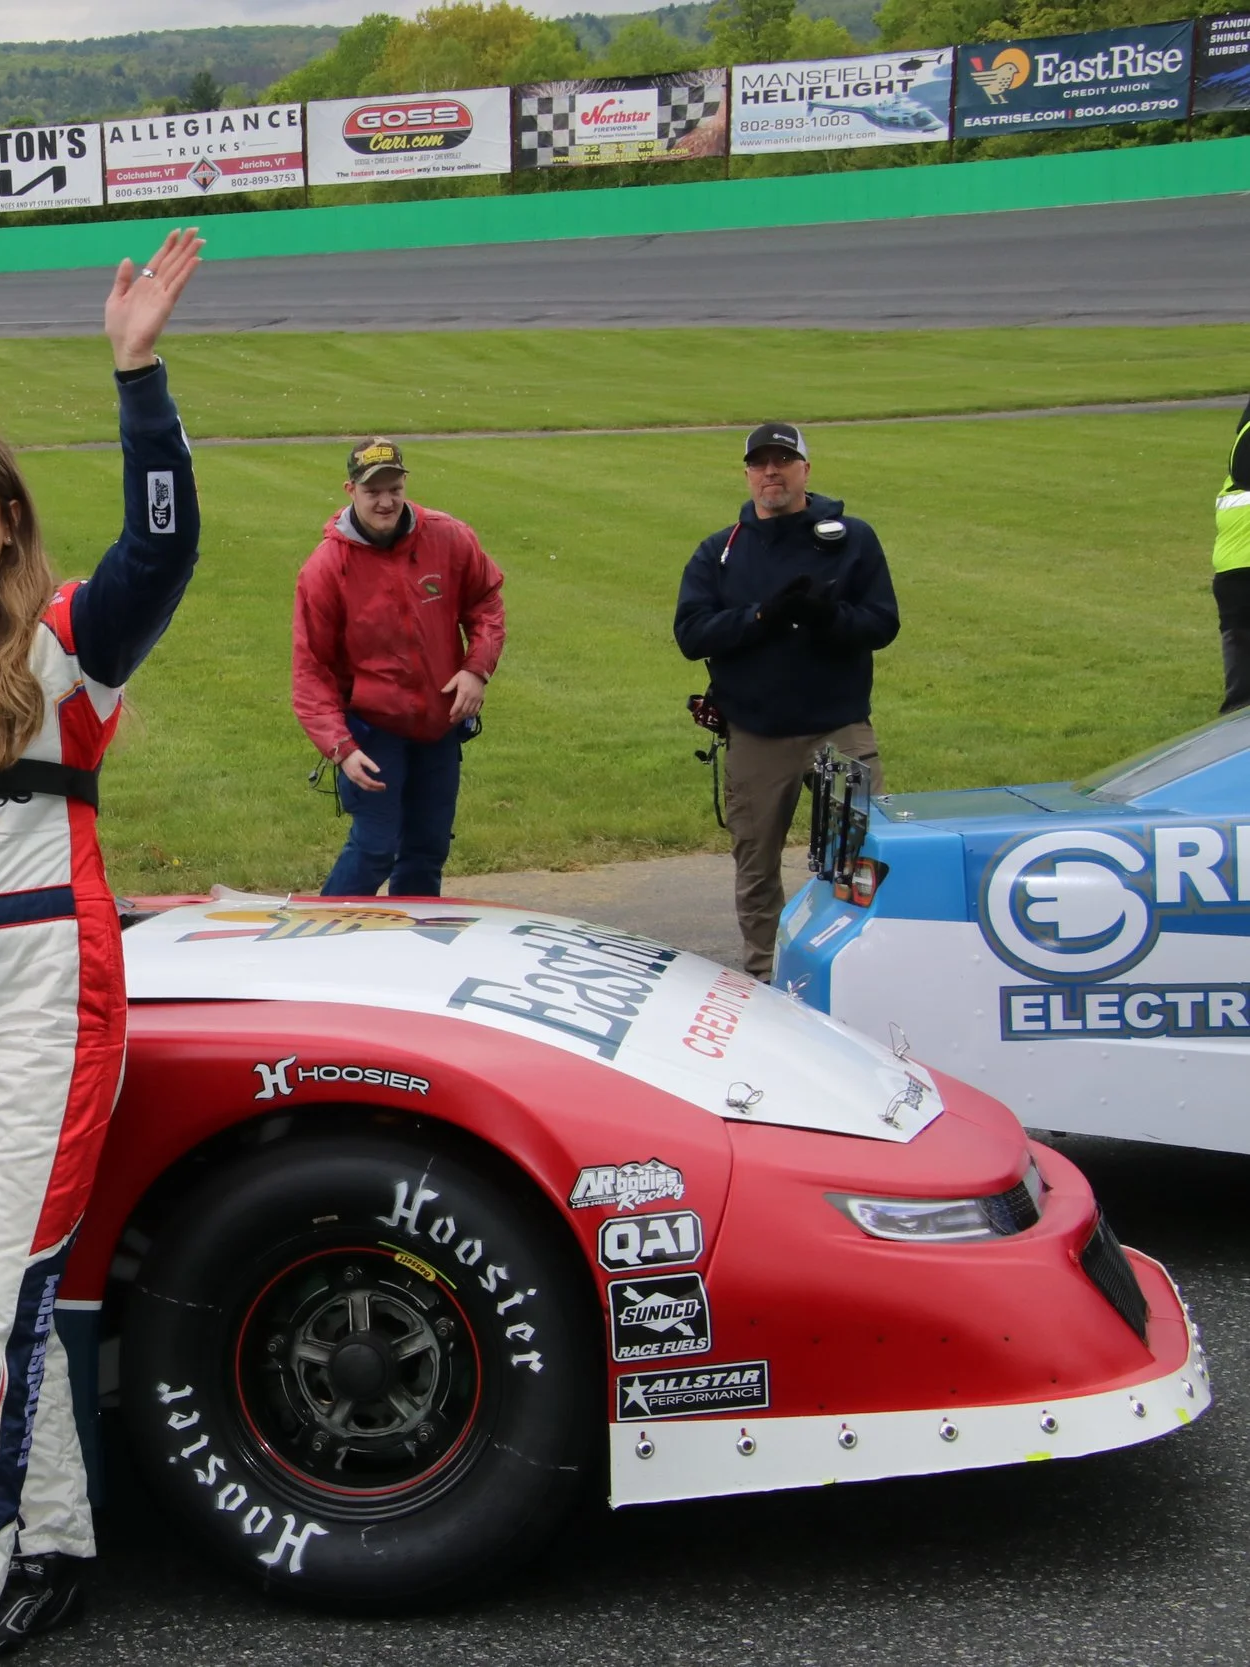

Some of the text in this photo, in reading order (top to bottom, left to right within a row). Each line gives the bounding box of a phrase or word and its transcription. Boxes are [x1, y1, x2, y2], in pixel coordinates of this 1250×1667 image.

[1208, 44, 1248, 56] RUBBER
[741, 64, 891, 89] MANSFIELD
[1033, 43, 1182, 87] EastRise
[741, 78, 914, 105] HELIFLIGHT
[1063, 83, 1150, 99] CREDIT UNION
[356, 106, 459, 129] GOSS
[581, 98, 651, 125] Northstar
[964, 99, 1179, 128] EASTRISE.COM 800.400.8790
[109, 109, 297, 144] ALLEGIANCE
[593, 125, 638, 133] FIREWORKS
[740, 115, 850, 132] 802-893-1003
[167, 142, 240, 157] TRUCKS
[369, 132, 444, 151] Cars.com
[739, 131, 876, 147] www.mansfieldheliflight.com
[117, 168, 175, 181] Colchester, VT
[239, 158, 286, 170] Jericho, VT
[115, 184, 179, 198] 800-639-1290
[231, 173, 296, 187] 802-899-3753
[16, 201, 28, 209] AND
[54, 197, 91, 206] INSPECTIONS
[1010, 991, 1250, 1032] ELECTR
[682, 992, 744, 1058] CREDIT
[298, 1066, 430, 1095] HOOSIER
[616, 1183, 685, 1212] Racing
[604, 1216, 695, 1265] QA1
[376, 1180, 545, 1374] Hoosier
[623, 1300, 696, 1324] SUNOCO
[618, 1337, 709, 1358] RACE FUELS
[647, 1370, 760, 1393] ALLSTAR
[649, 1387, 762, 1406] PERFORMANCE
[157, 1382, 329, 1573] Hoosier
